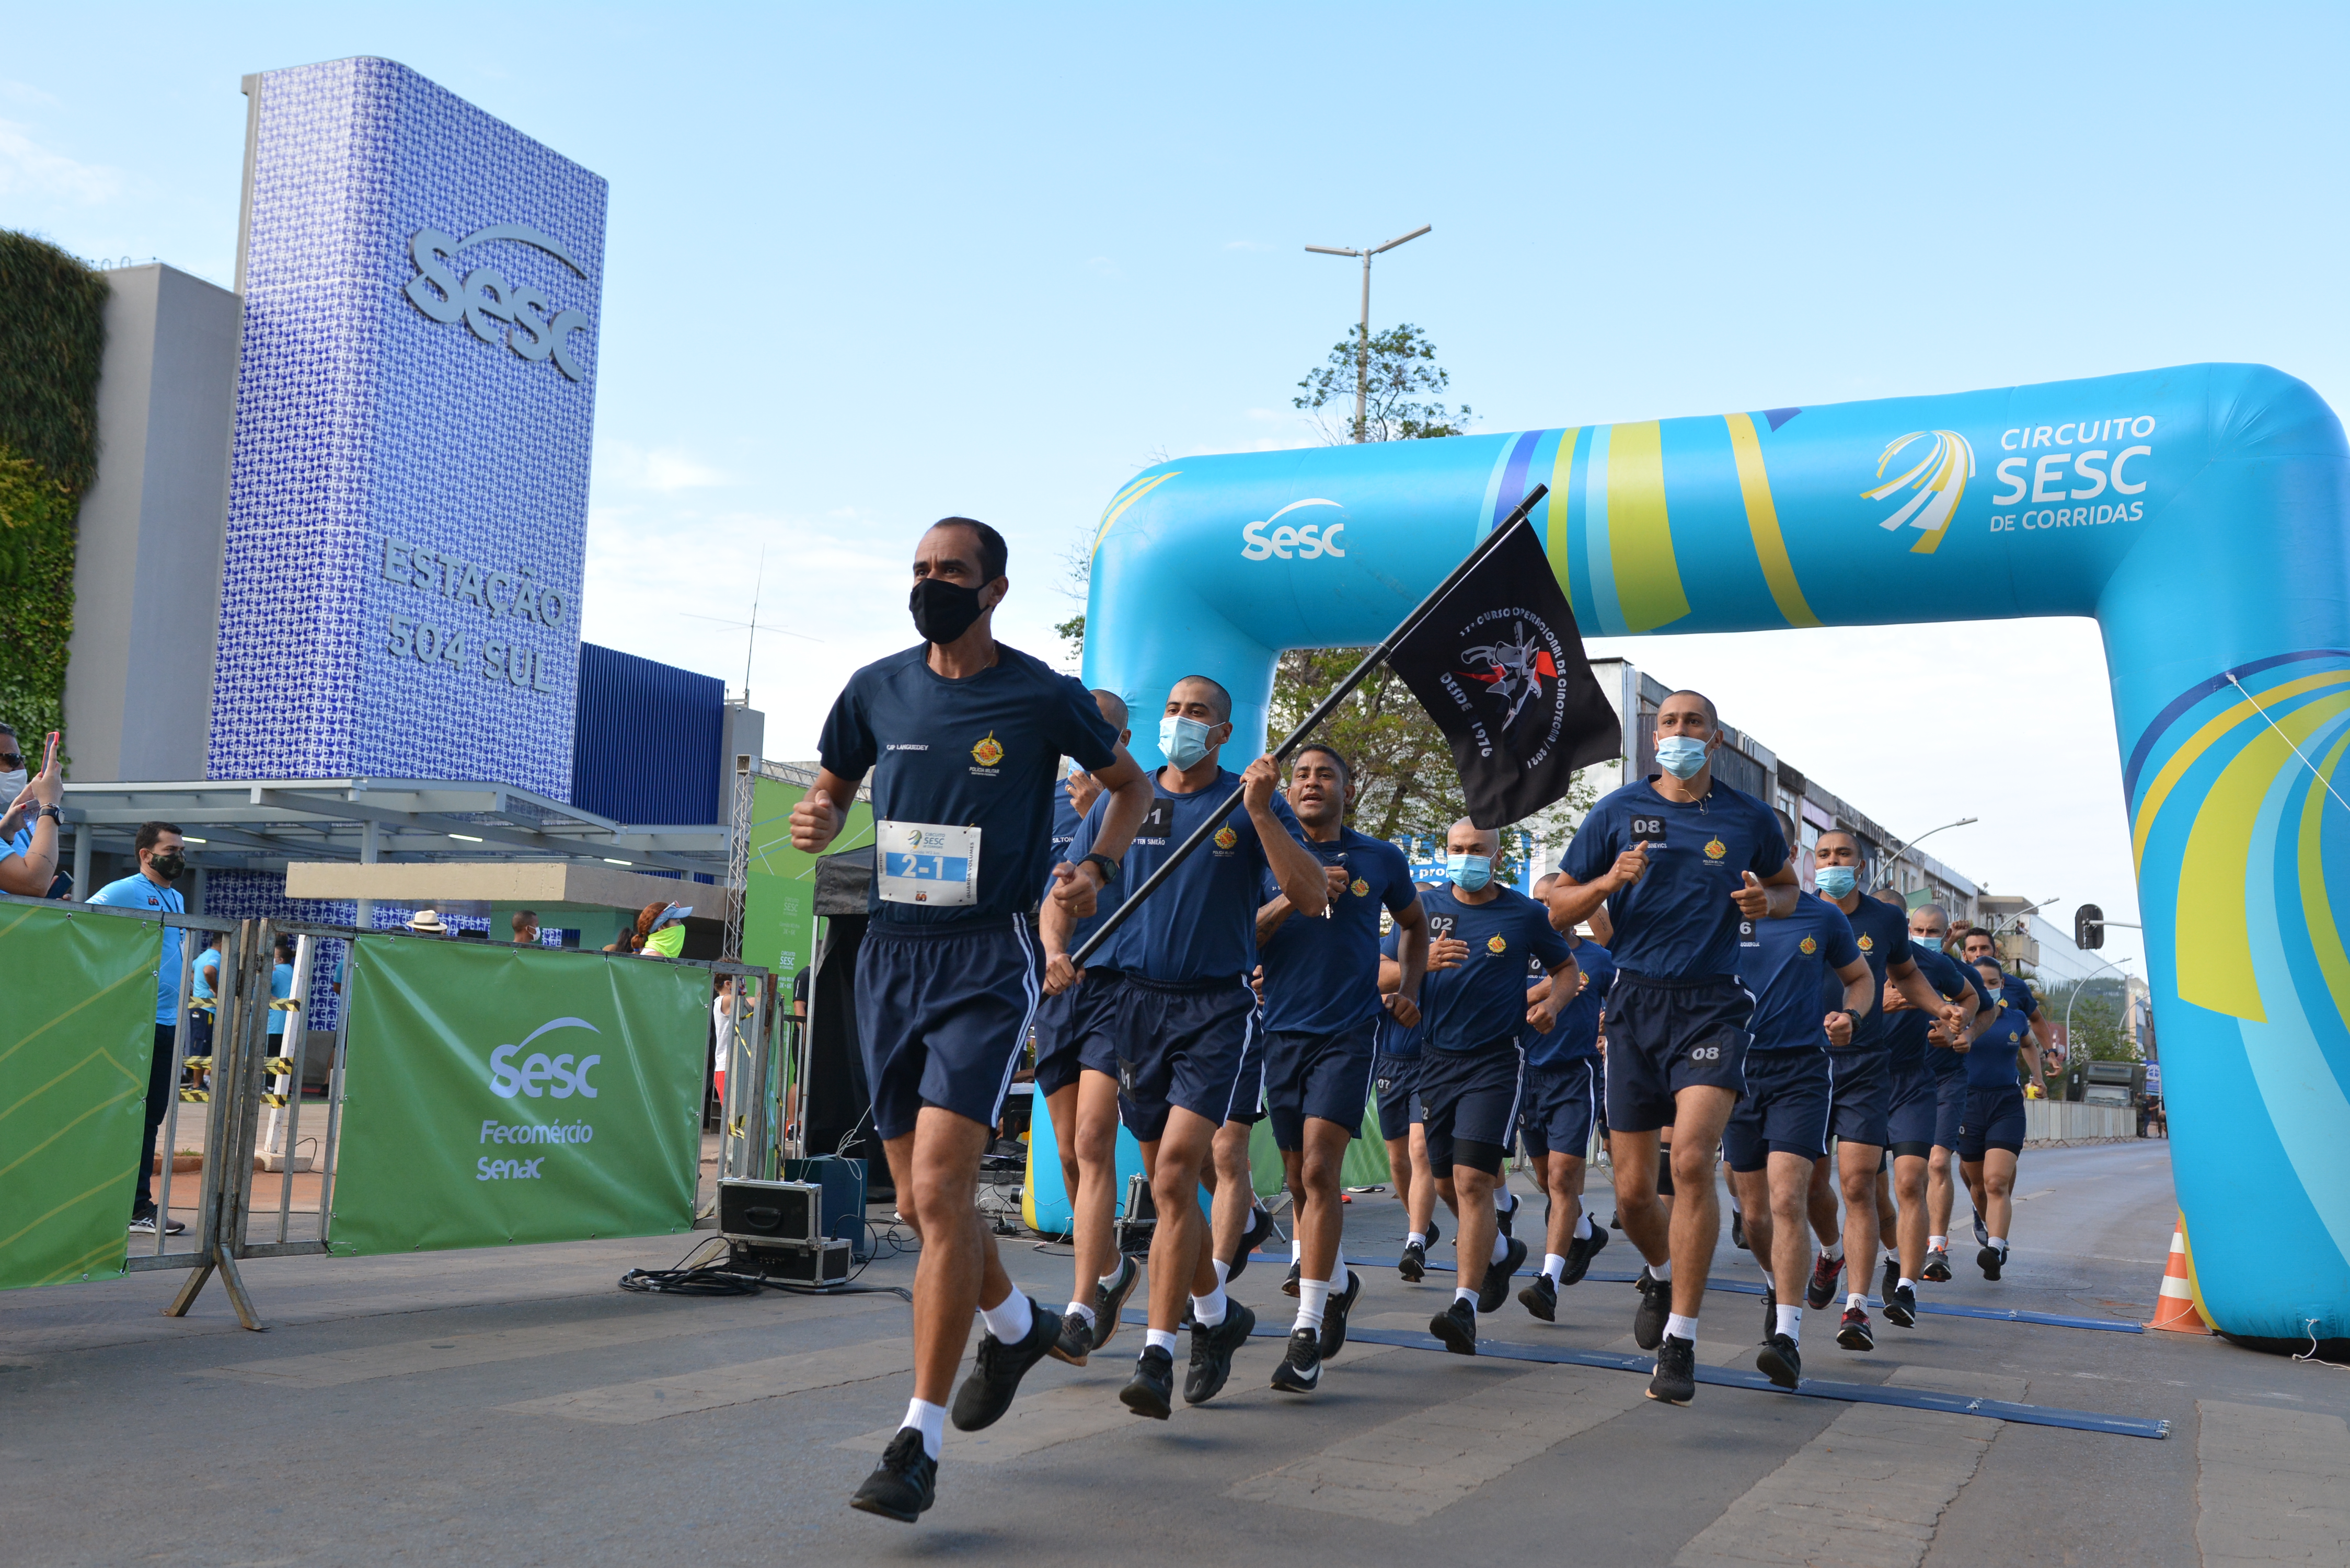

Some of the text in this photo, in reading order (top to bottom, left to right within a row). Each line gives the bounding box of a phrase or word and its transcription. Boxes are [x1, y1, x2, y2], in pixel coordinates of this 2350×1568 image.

[401, 224, 588, 382] Sesc
[2001, 416, 2156, 450] CIRCUITO
[1993, 445, 2152, 505] SESC
[1241, 498, 1345, 560] Sesc
[1990, 501, 2143, 532] DE CORRIDAS
[383, 537, 566, 628] ESTAÇÃO
[1477, 608, 1511, 625] CURSO
[1512, 607, 1563, 659] OPERACIONAL
[387, 613, 552, 693] 504 SUL
[1556, 660, 1566, 675] DE
[1439, 672, 1493, 757] DESDE 1976
[1527, 747, 1547, 769] 2021
[1142, 809, 1161, 824] 1
[1634, 820, 1660, 833] 08
[901, 854, 943, 880] 2-1
[784, 903, 799, 912] SESC
[1431, 917, 1453, 930] 02
[780, 956, 794, 966] SESC
[489, 1017, 601, 1099] Sesc
[1692, 1047, 1719, 1060] 08
[1121, 1068, 1130, 1090] 01
[480, 1119, 593, 1144] Fecomércio
[476, 1156, 545, 1181] Senac
